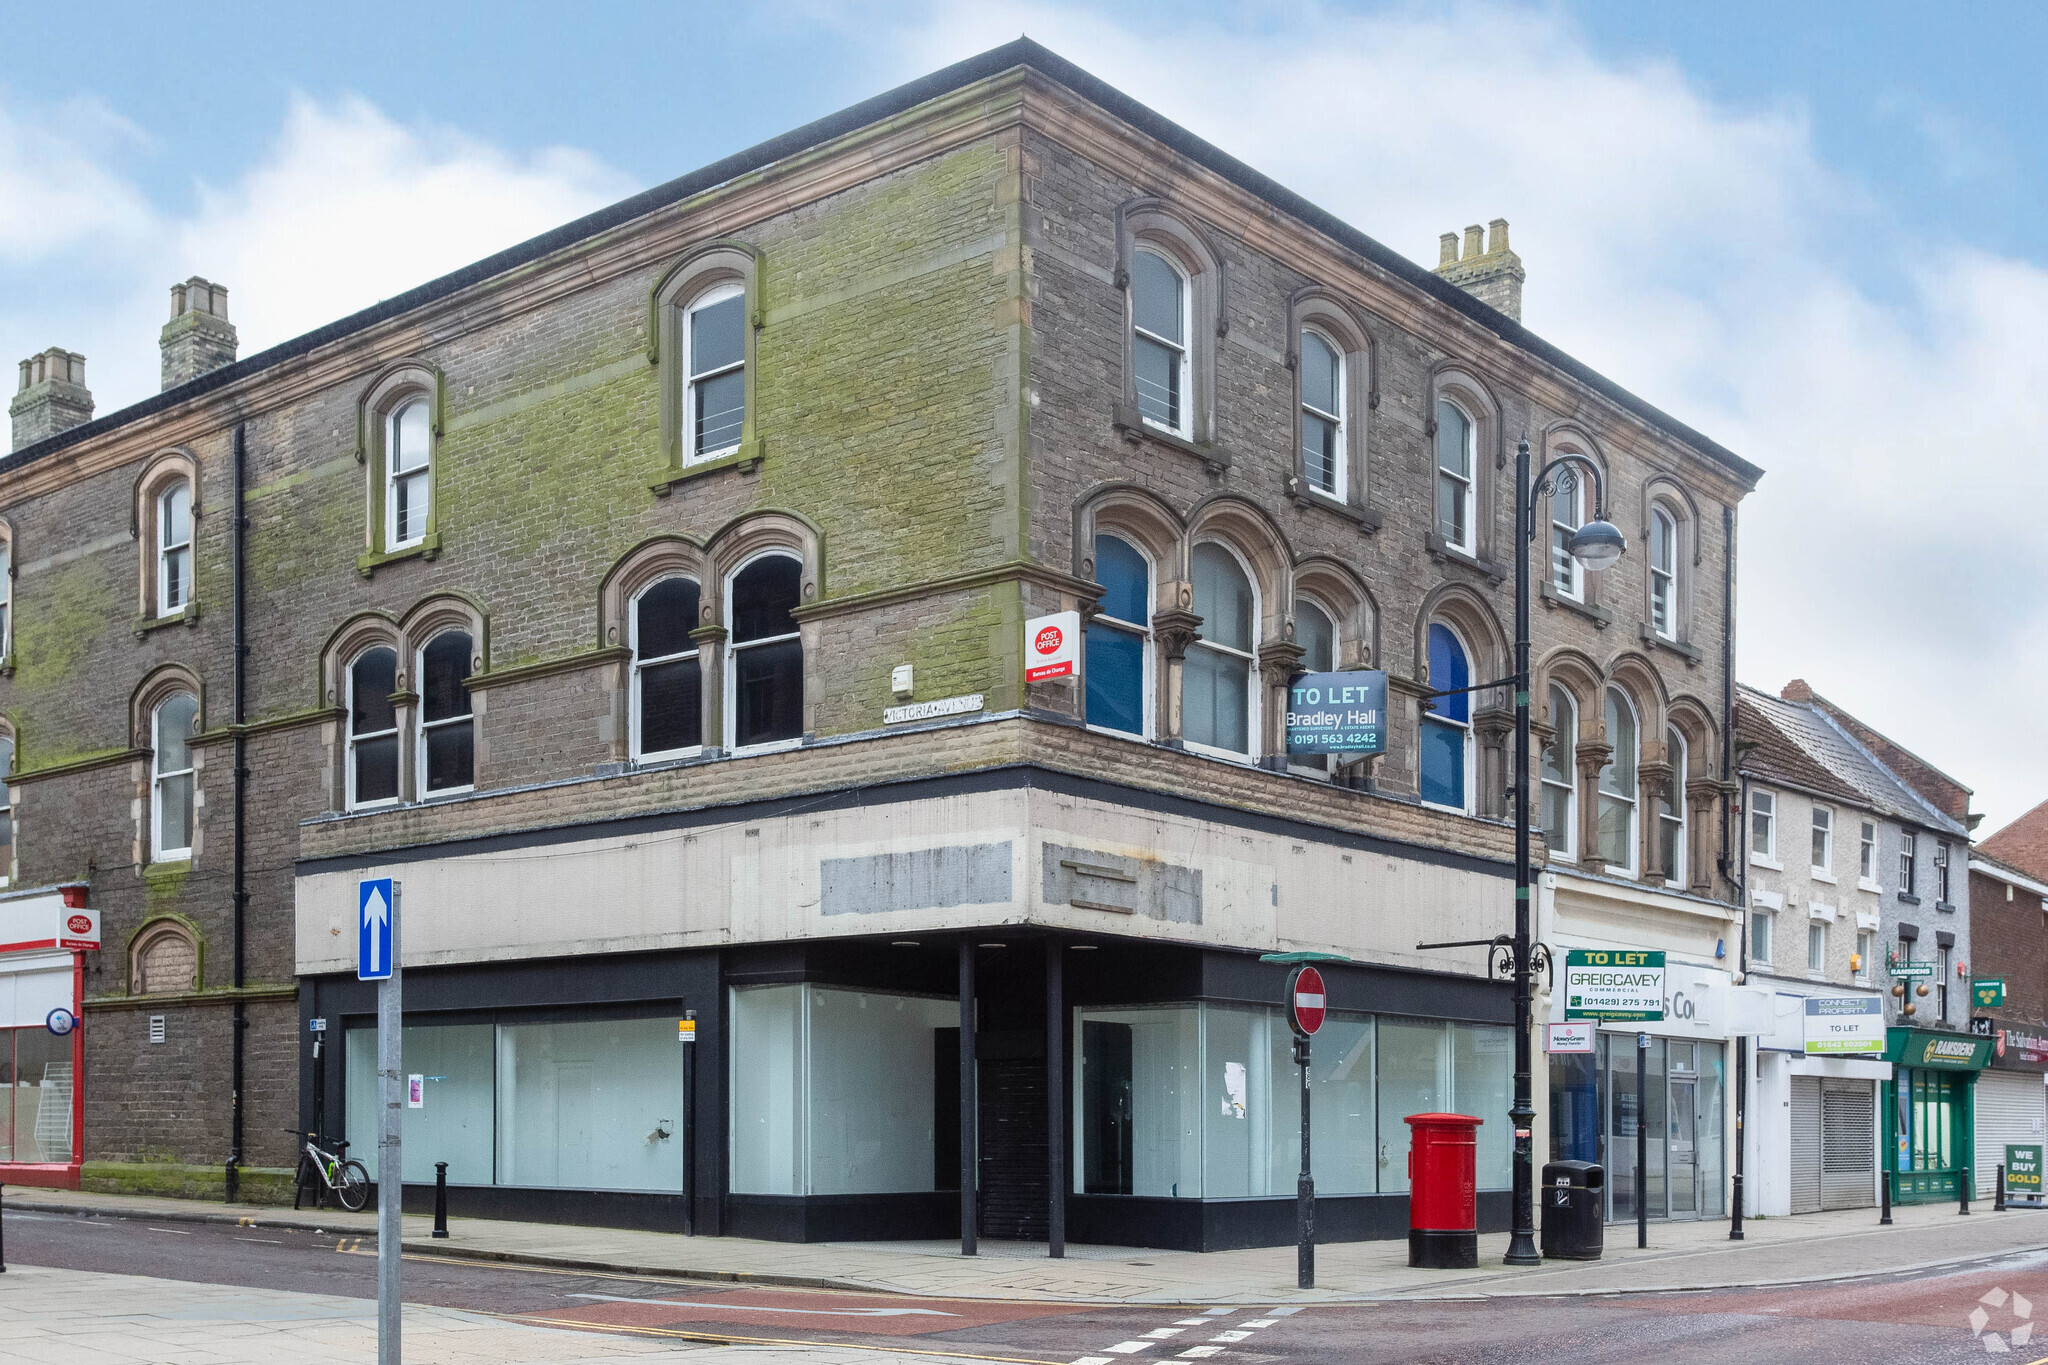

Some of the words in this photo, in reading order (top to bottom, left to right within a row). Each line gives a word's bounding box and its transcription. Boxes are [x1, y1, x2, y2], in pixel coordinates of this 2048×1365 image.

[1041, 630, 1057, 641] POST
[1037, 638, 1060, 650] OFFICE
[1293, 688, 1321, 705] TO
[1328, 686, 1369, 704] LET
[886, 704, 933, 722] VICTORIA
[937, 696, 982, 714] AVENUE
[1286, 711, 1343, 730] Bradley
[1347, 709, 1376, 725] Hall
[1294, 735, 1318, 744] 0191
[1321, 734, 1343, 744] 563
[1346, 733, 1376, 743] 4242
[1584, 952, 1608, 964] TO
[1615, 953, 1648, 965] LET
[1570, 973, 1661, 986] GREIGCAVEY
[1584, 998, 1620, 1006] (01429)
[2006, 1030, 2015, 1046] The
[1934, 1040, 1976, 1057] RAMSDENS
[2014, 1150, 2034, 1160] WE
[2011, 1162, 2036, 1171] BUY
[2007, 1173, 2040, 1184] GOLD
